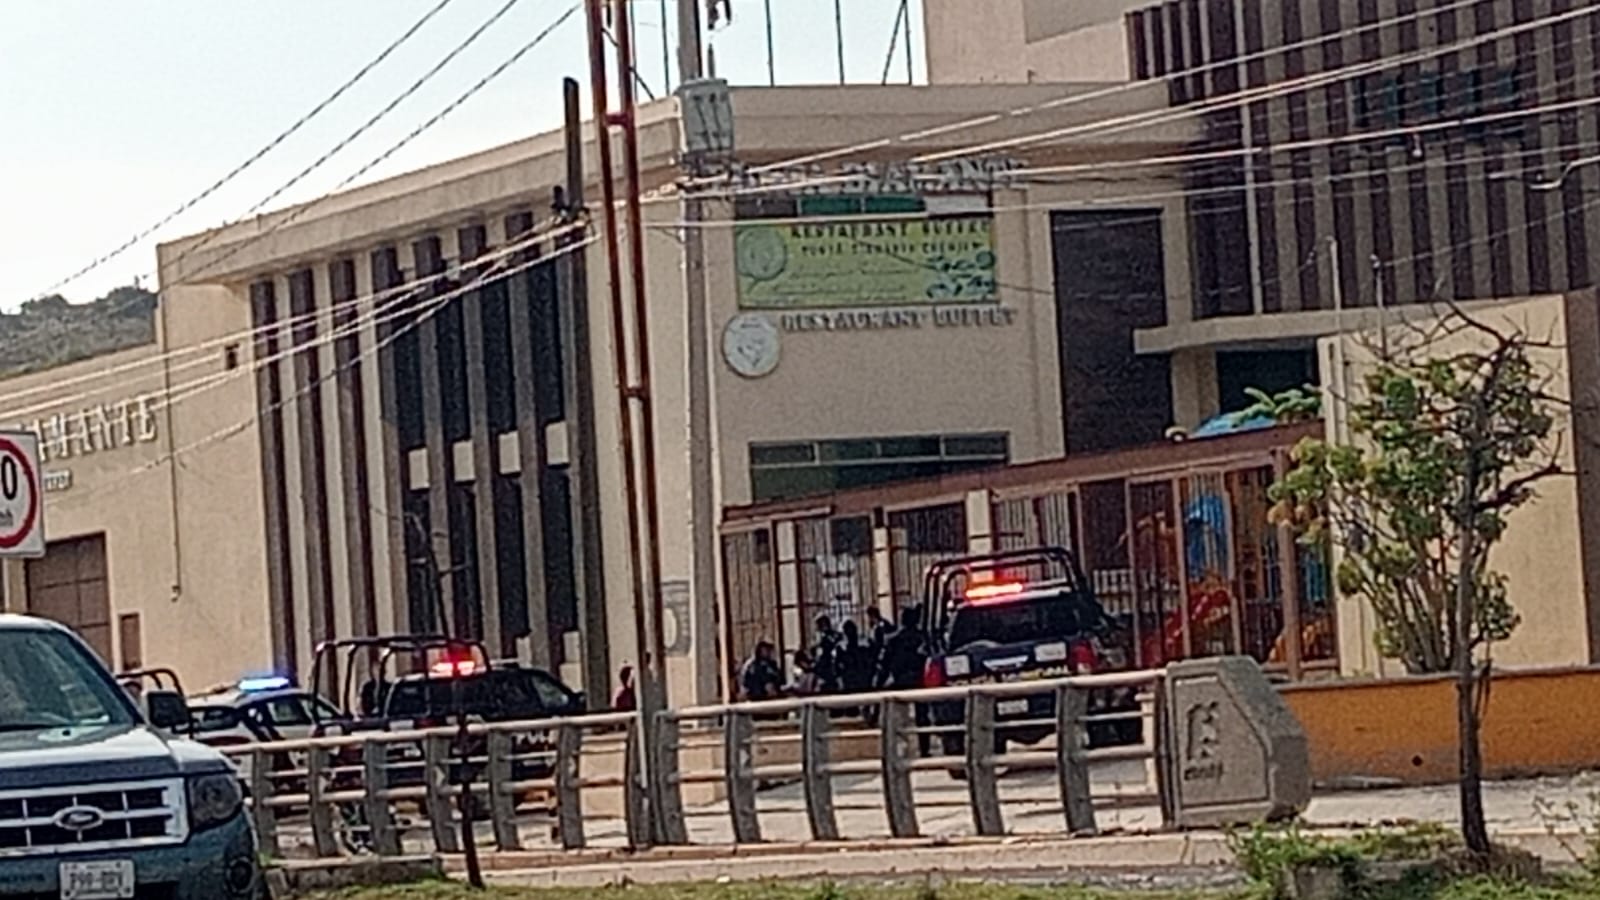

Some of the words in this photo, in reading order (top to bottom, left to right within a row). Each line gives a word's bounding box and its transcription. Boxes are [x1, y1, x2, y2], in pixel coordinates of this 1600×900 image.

[781, 309, 922, 333] RESTAURANT
[932, 303, 1017, 328] BUFFET
[0, 455, 18, 500] 0
